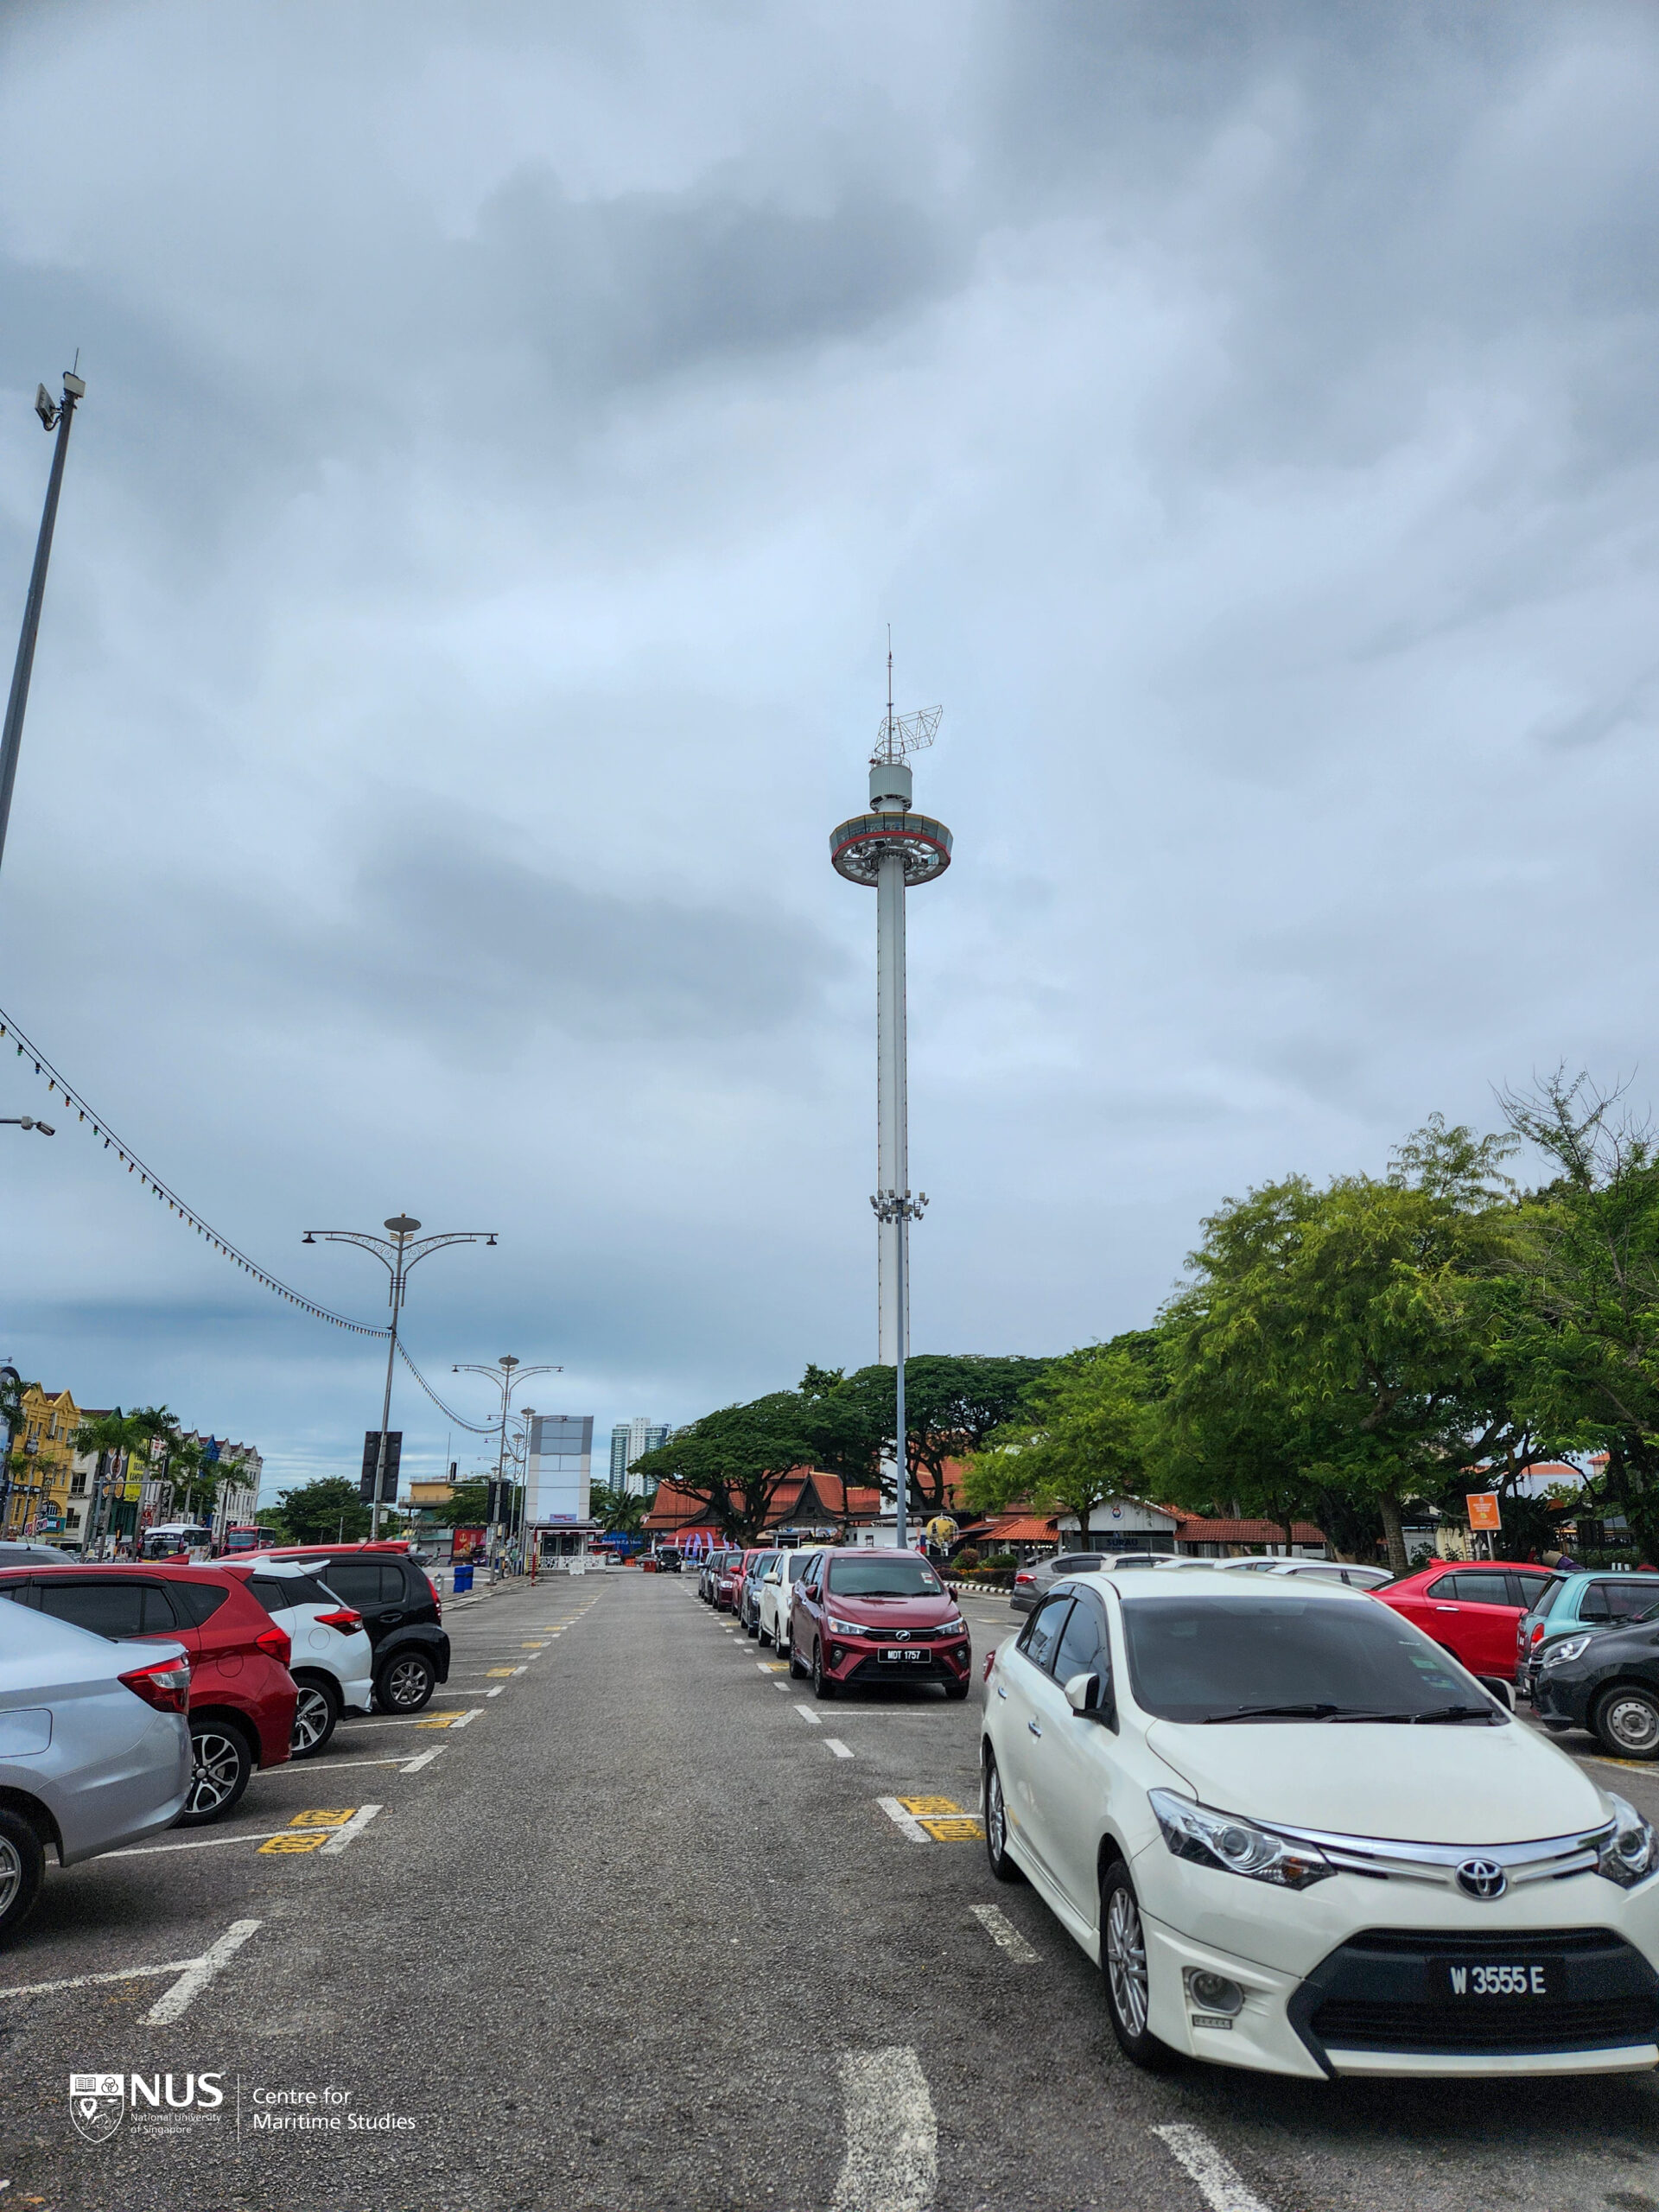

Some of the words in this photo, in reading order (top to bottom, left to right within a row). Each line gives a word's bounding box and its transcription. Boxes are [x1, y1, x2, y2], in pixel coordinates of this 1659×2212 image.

[887, 1650, 901, 1659] MDT
[905, 1650, 920, 1659] 1757
[270, 1835, 321, 1851] 123
